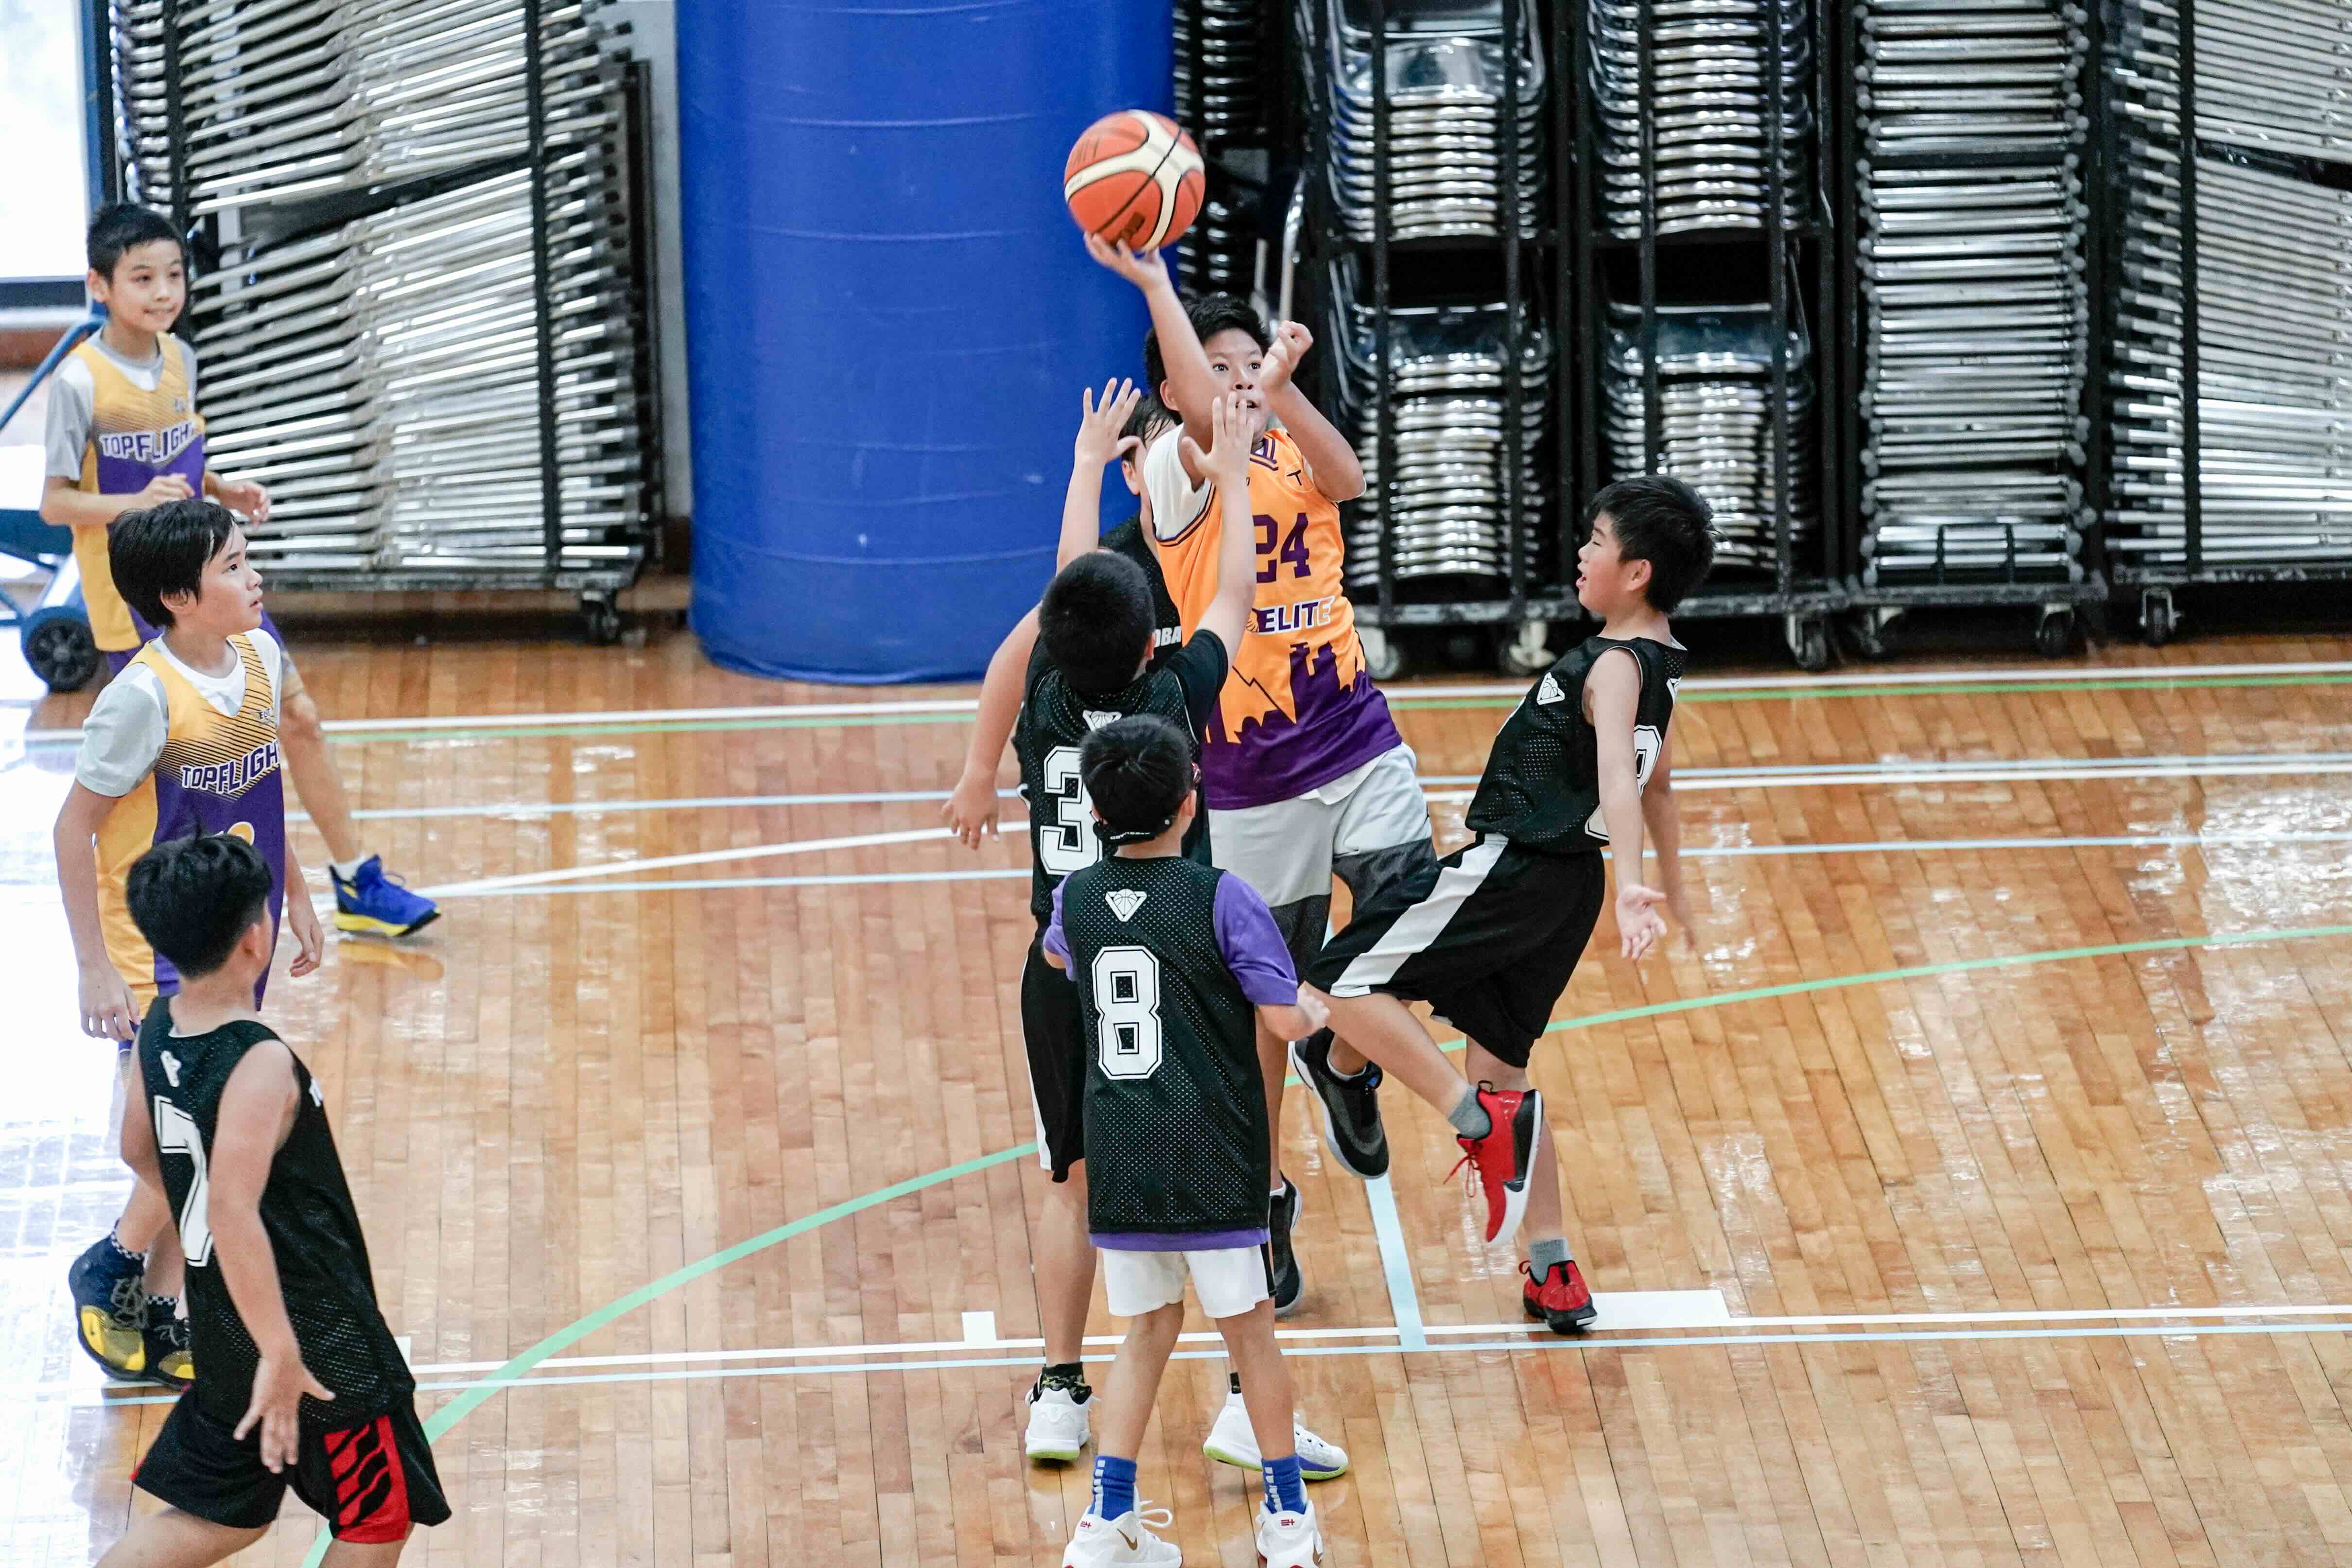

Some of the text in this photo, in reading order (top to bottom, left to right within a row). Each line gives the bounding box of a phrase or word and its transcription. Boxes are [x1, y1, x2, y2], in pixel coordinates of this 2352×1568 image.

[1252, 512, 1311, 584] 24
[1257, 595, 1336, 635] ELITE
[180, 738, 280, 795] TOPFLIGH
[1040, 746, 1103, 876] 3
[1092, 945, 1163, 1080] 8
[154, 1095, 214, 1267] 7
